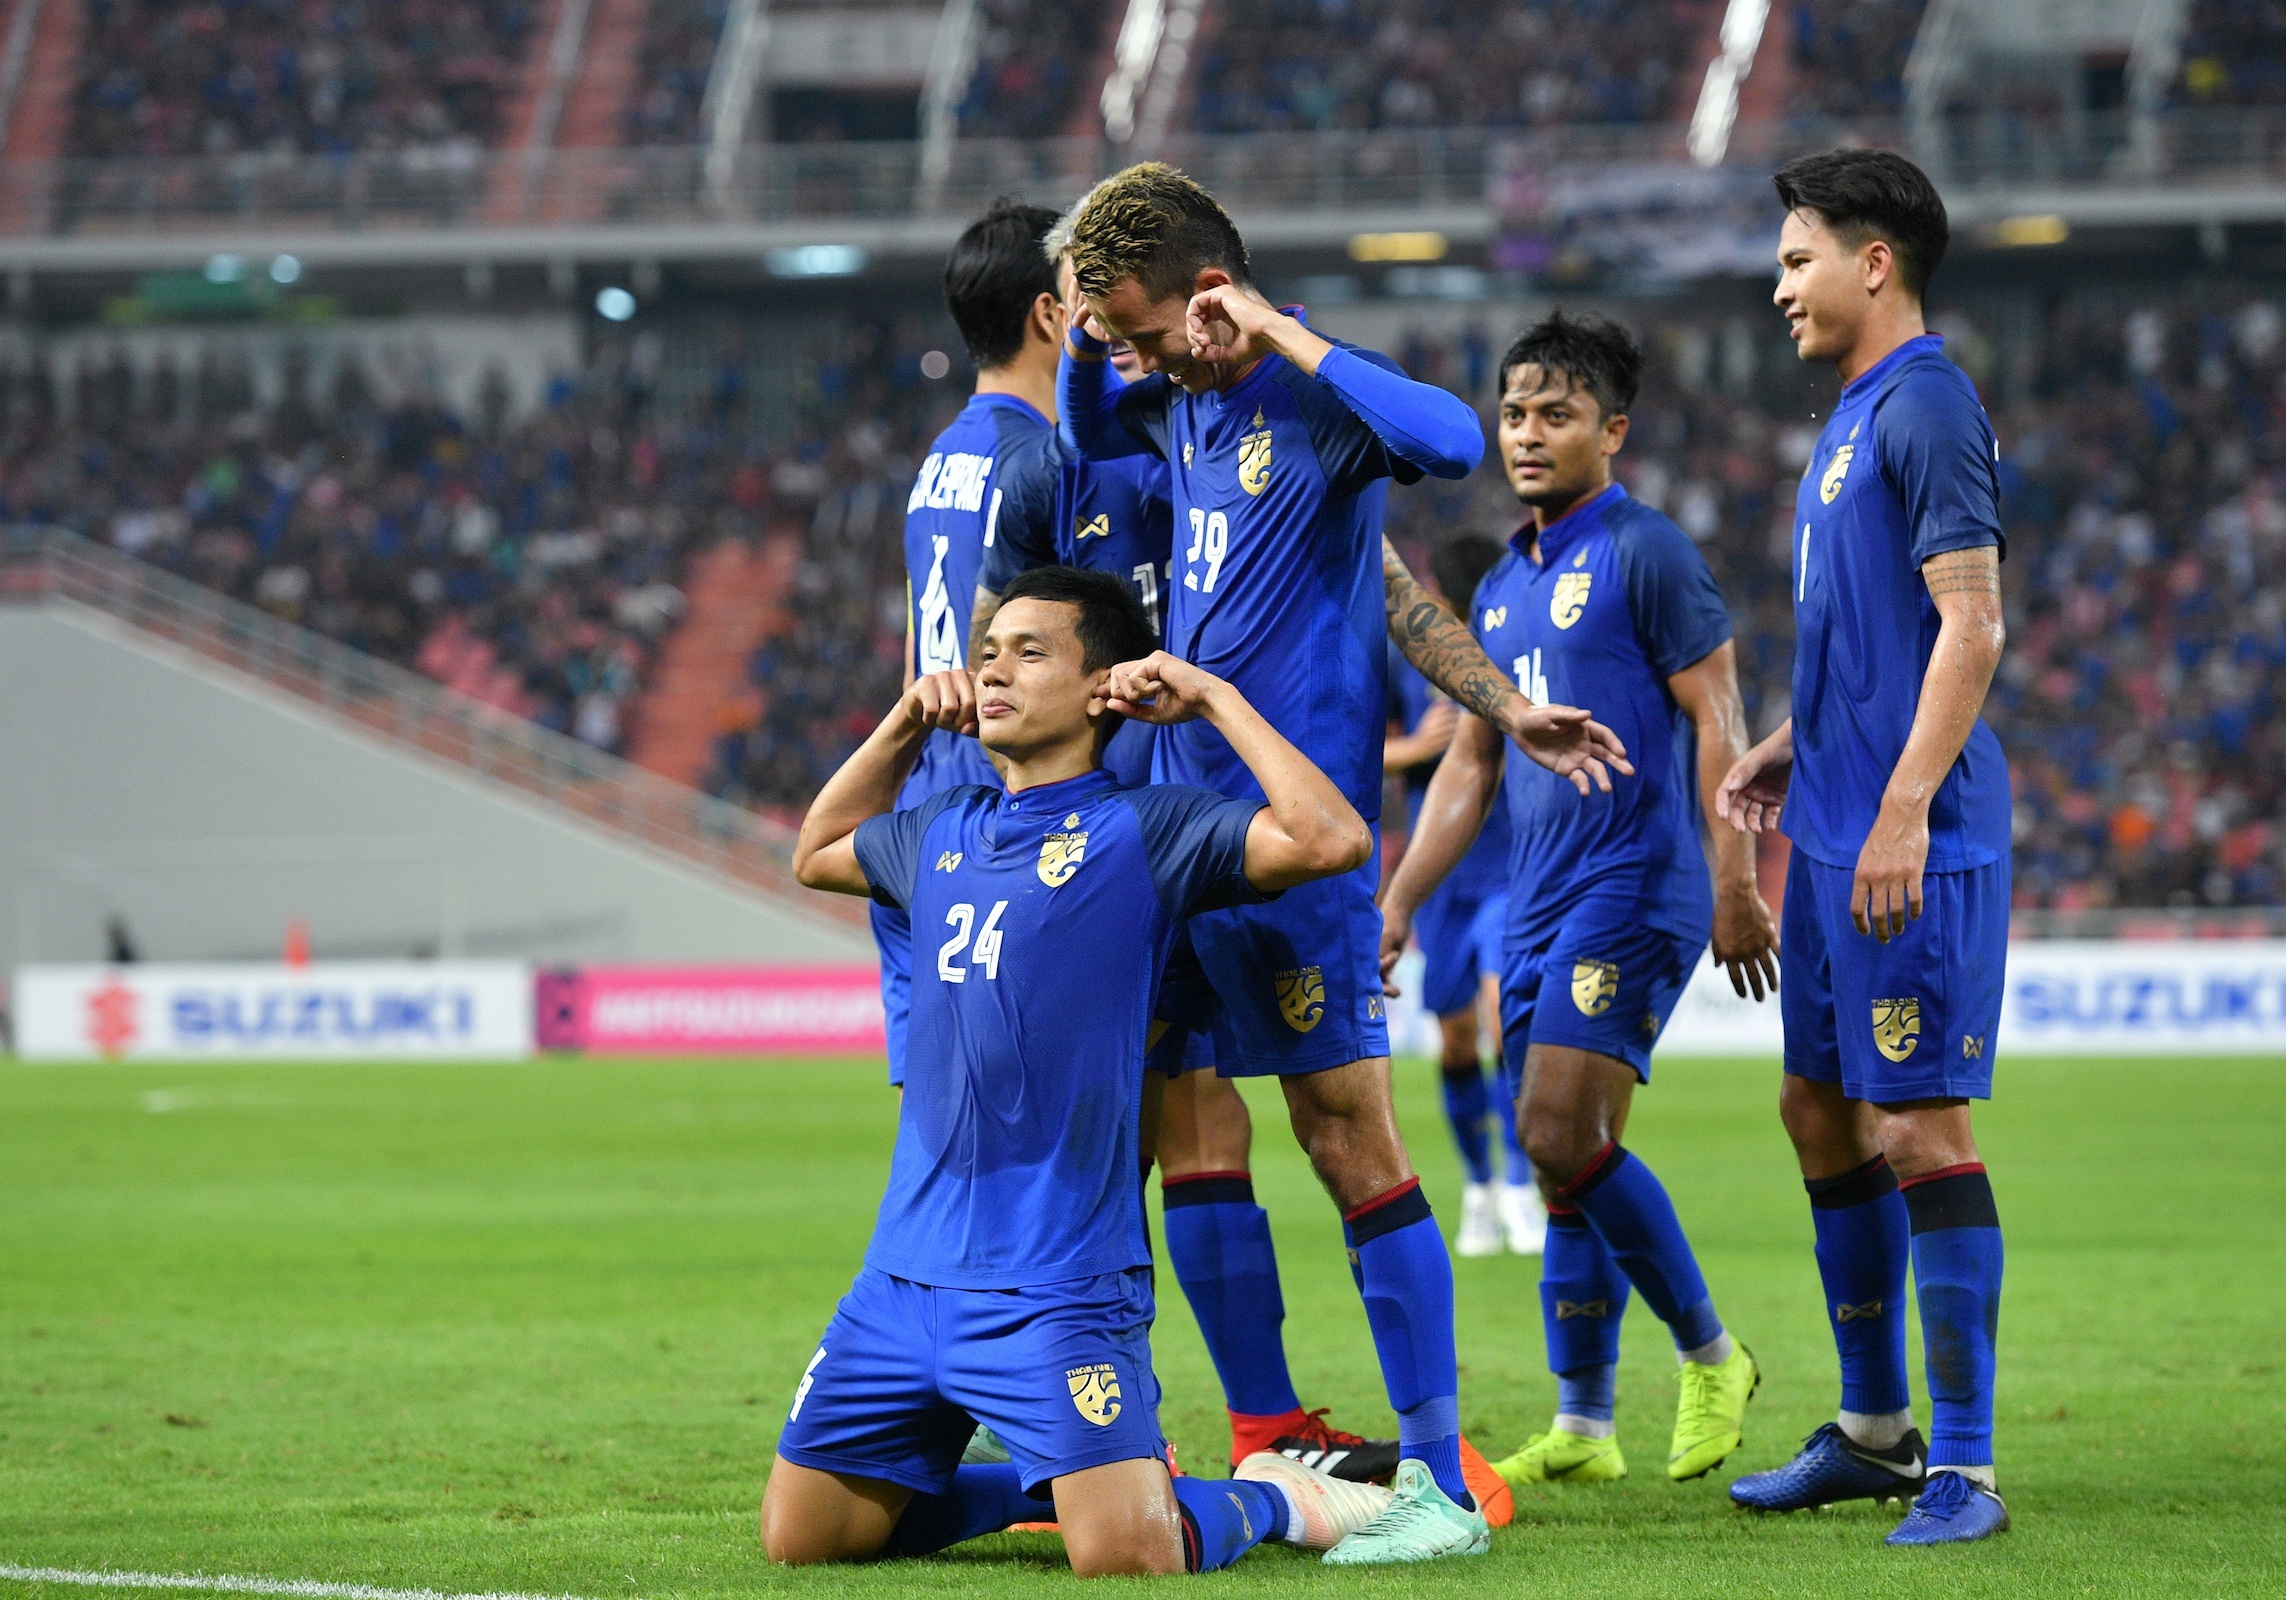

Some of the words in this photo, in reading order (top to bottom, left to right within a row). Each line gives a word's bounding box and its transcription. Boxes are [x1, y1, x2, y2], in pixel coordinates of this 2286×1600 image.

[1183, 507, 1229, 594] 29
[1043, 831, 1089, 842] THAILAND
[937, 899, 1009, 983] 24
[171, 984, 474, 1038] SUZUKI
[1871, 997, 1919, 1008] THAILAND
[1065, 1363, 1114, 1378] THAILAND
